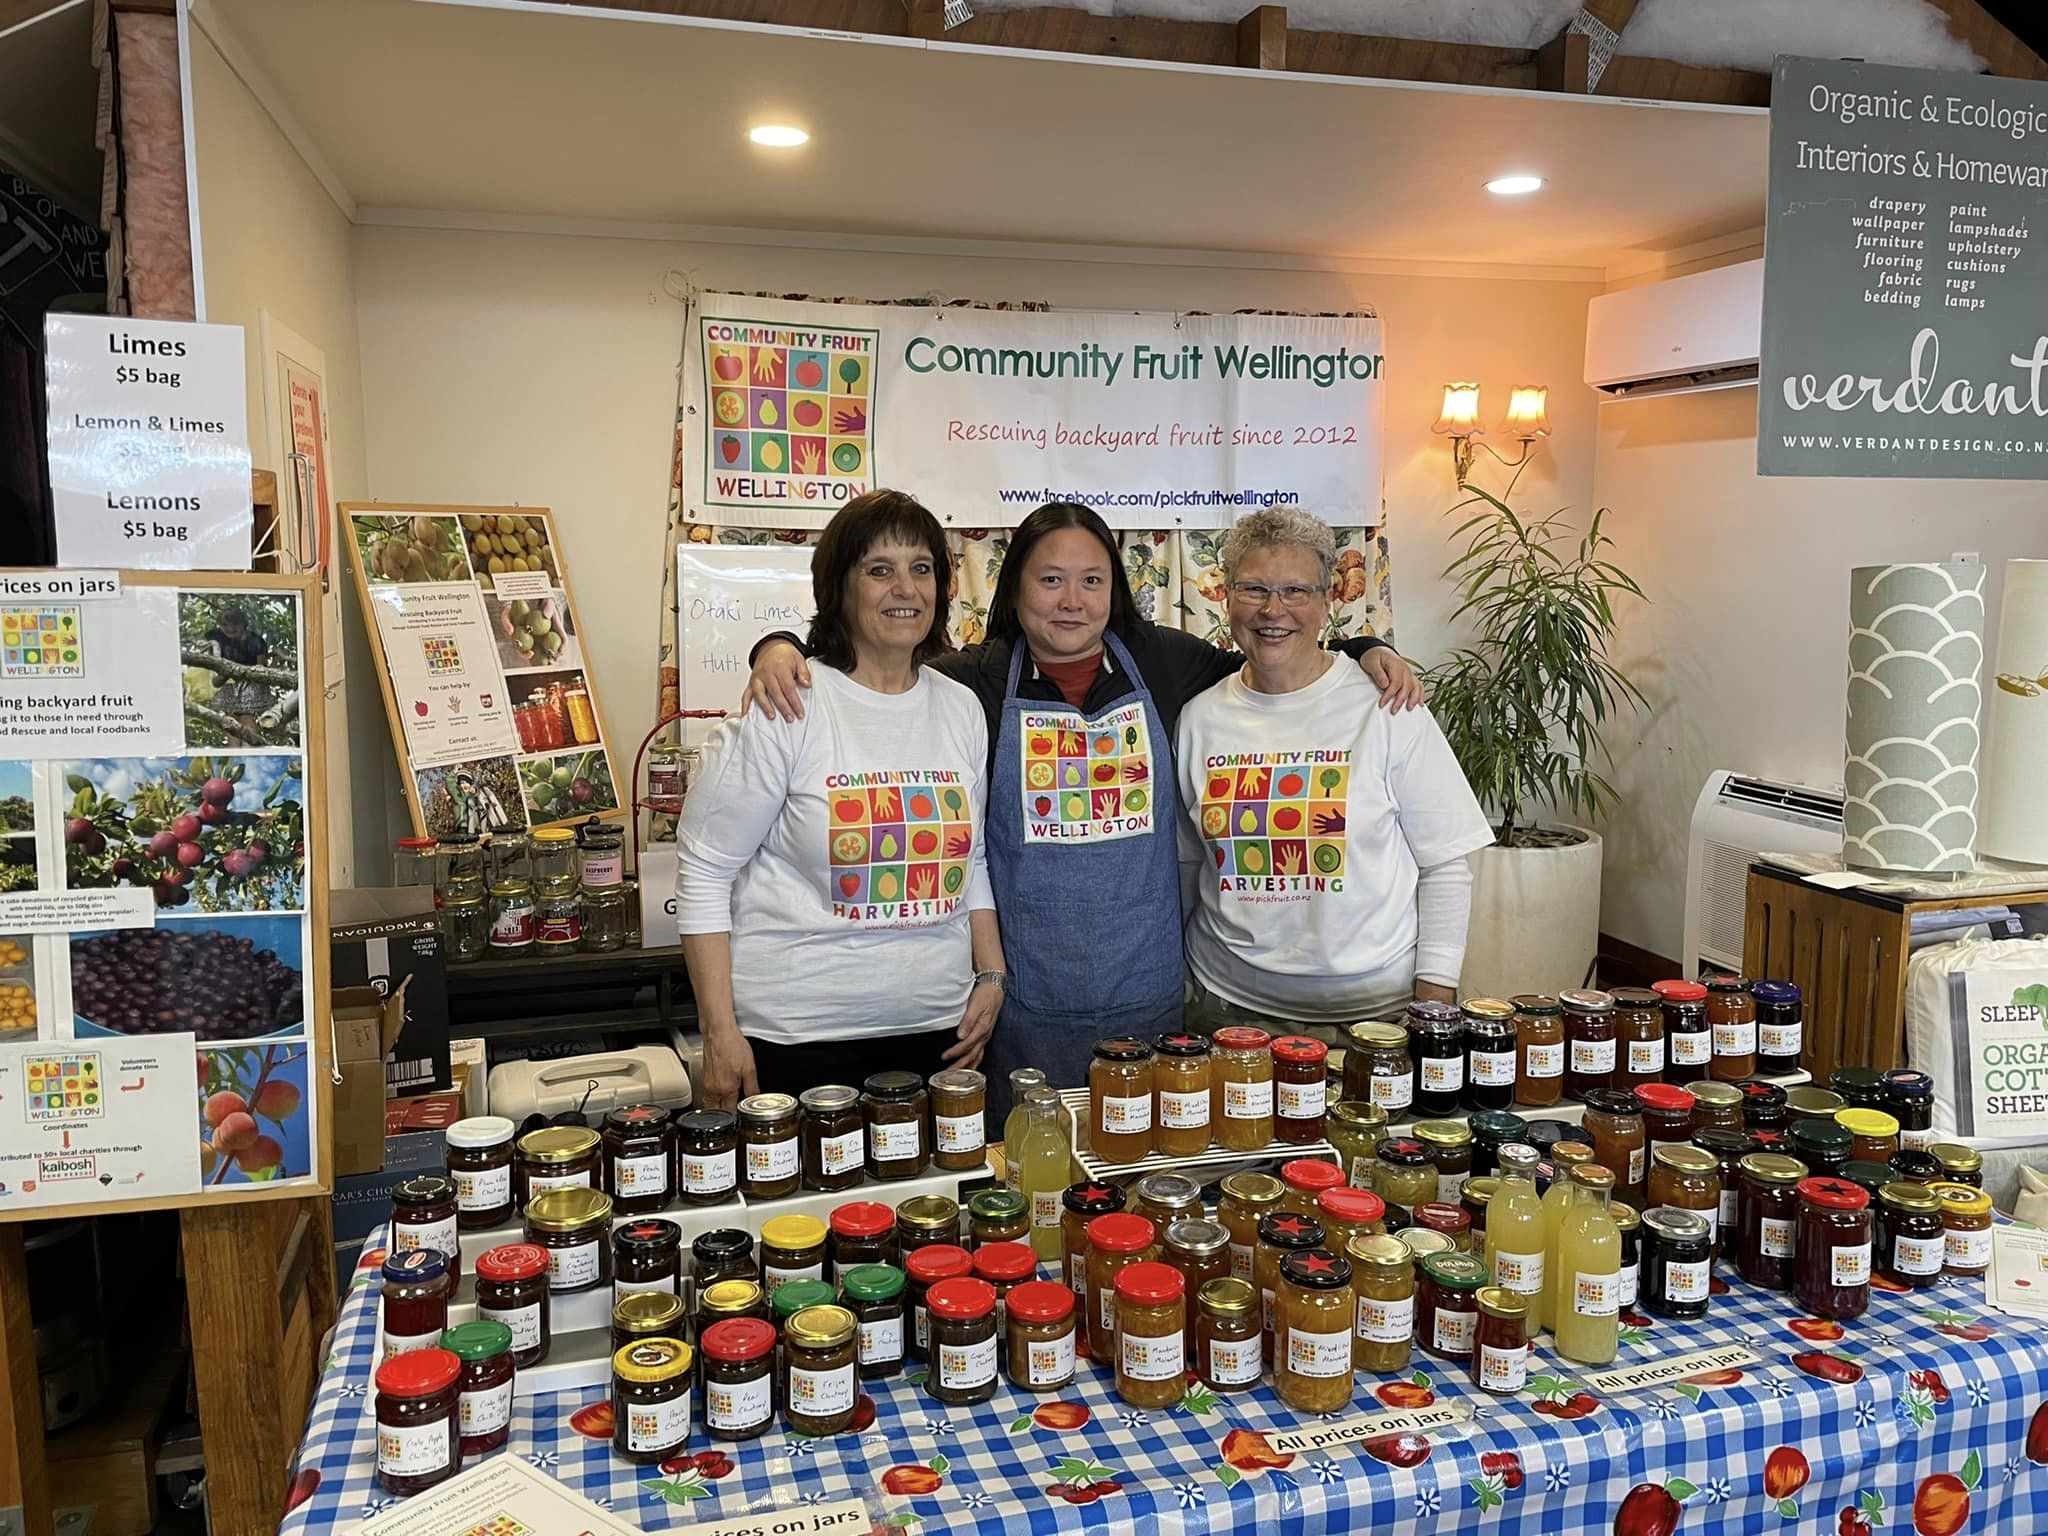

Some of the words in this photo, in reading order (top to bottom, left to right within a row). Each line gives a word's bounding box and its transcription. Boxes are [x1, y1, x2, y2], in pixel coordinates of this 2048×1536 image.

[1810, 85, 1912, 124] Organic
[1920, 95, 1939, 123] &
[1946, 97, 2047, 139] Ecologic
[1796, 141, 1906, 176] Interiors
[1912, 151, 1931, 178] &
[1936, 152, 2048, 188] Homewar
[1869, 196, 1926, 215] drapery
[1950, 203, 1987, 218] paint
[1852, 215, 1925, 233] wallpaper
[1949, 221, 2029, 239] lampshades
[62, 224, 98, 246] AND
[1855, 233, 1924, 249] furniture
[1948, 240, 2021, 259] upholstery
[1863, 252, 1923, 271] flooring
[1947, 259, 2006, 273] cushions
[1878, 271, 1922, 287] fabric
[1945, 278, 1976, 293] rugs
[1864, 290, 1921, 309] bedding
[1944, 294, 1986, 311] lamps
[109, 333, 186, 357] Limes
[707, 326, 817, 348] COMMUNITY
[822, 334, 871, 352] FRUIT
[905, 336, 1123, 386] Community
[1133, 345, 1203, 381] Fruit
[1214, 345, 1384, 388] Wellington
[116, 366, 139, 384] $5
[146, 367, 181, 388] bag
[1783, 328, 2048, 416] verdant
[75, 414, 140, 431] Lemon
[148, 416, 162, 431] &
[169, 417, 225, 434] Limes
[948, 420, 1046, 450] Rescuing
[1055, 423, 1159, 453] backyard
[1169, 423, 1222, 447] fruit
[1232, 424, 1284, 446] since
[1293, 425, 1358, 445] 2012
[1783, 436, 2048, 453] WWW.VERDANTDESIGN.CO.N
[717, 476, 866, 501] WELLINGTON
[107, 491, 201, 511] Lemons
[124, 520, 146, 538] $5
[153, 522, 188, 541] bag
[49, 581, 73, 593] on
[79, 577, 115, 596] jars
[690, 598, 741, 622] Otaki
[7, 666, 80, 675] WELLIGTON
[702, 652, 741, 673] Hutt
[28, 695, 96, 710] backyard
[101, 695, 133, 706] fruit
[10, 714, 17, 722] it
[33, 713, 61, 722] those
[64, 713, 73, 721] in
[77, 712, 101, 721] need
[104, 711, 143, 722] through
[1107, 709, 1140, 727] FRUIT
[11, 727, 47, 735] Rescue
[49, 726, 68, 735] and
[71, 725, 94, 734] local
[97, 725, 150, 734] Foodbanks
[1207, 752, 1301, 768] COMMUNITY
[1304, 750, 1352, 763] FRUIT
[826, 771, 920, 788] COMMUNITY
[924, 771, 961, 783] FRUIT
[1032, 815, 1149, 837] WELLINGTON
[1220, 877, 1344, 893] ARVESTING
[1981, 1004, 2040, 1023] SLEEP
[1985, 1068, 2048, 1092] COT
[31, 1107, 100, 1120] WELLIGTON
[1987, 1095, 2048, 1114] SHEE
[43, 1122, 88, 1131] Coordinates
[44, 1151, 57, 1159] 50+
[79, 1146, 111, 1155] charities
[113, 1144, 143, 1153] through
[42, 1159, 92, 1172] kaibosh
[1596, 1374, 1625, 1388] All
[1626, 1365, 1684, 1386] prices
[1686, 1359, 1709, 1370] on
[1713, 1351, 1750, 1367] jars
[1277, 1435, 1306, 1451] All
[1310, 1421, 1377, 1447] prices
[1380, 1416, 1410, 1430] on
[1412, 1410, 1454, 1427] jars
[772, 1520, 805, 1535] on
[813, 1510, 860, 1531] jars
